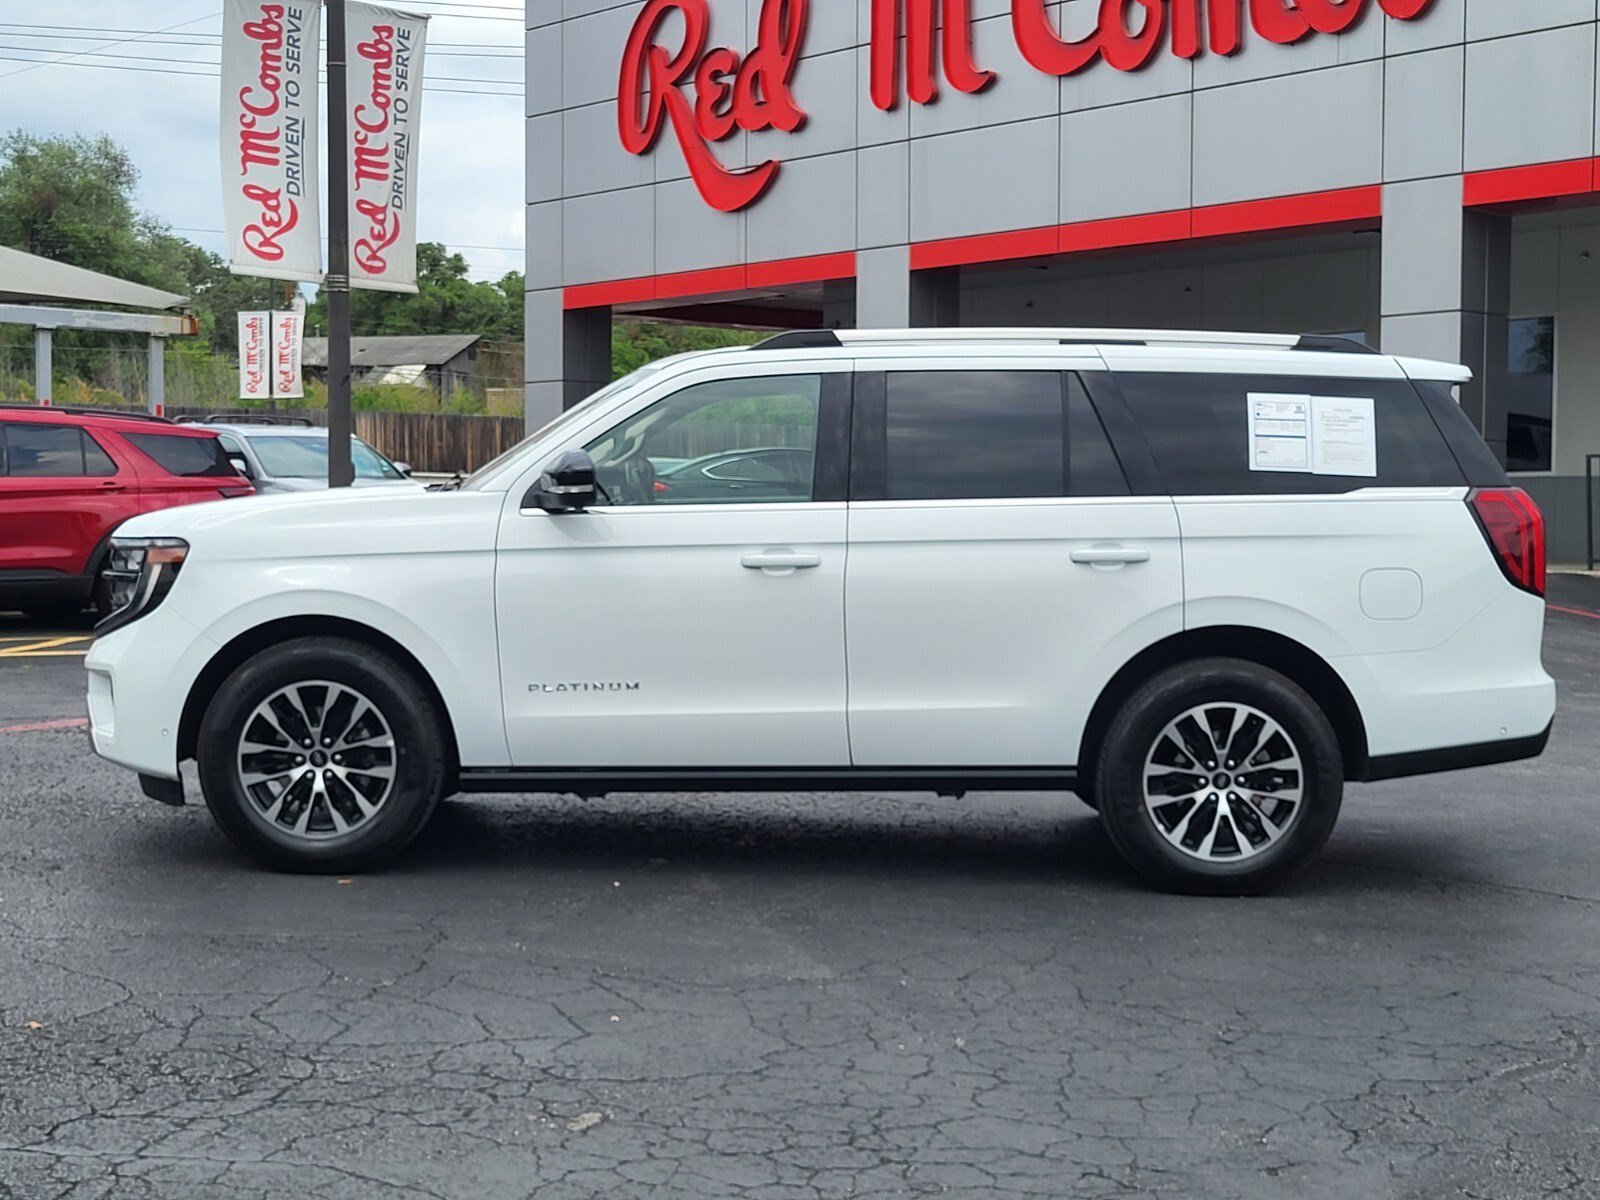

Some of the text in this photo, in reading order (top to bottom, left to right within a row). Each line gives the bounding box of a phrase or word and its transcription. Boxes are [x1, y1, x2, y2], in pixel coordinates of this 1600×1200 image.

[239, 4, 298, 261] Red McCombs
[285, 6, 302, 197] DRIVEN TO SERVE
[354, 25, 400, 275] Red McCombs
[391, 27, 411, 211] DRIVEN TO SERVE
[617, 0, 808, 213] Red
[246, 317, 263, 393] Red McCombs
[279, 317, 295, 393] Red McCombs
[528, 682, 640, 692] PLATINUM
